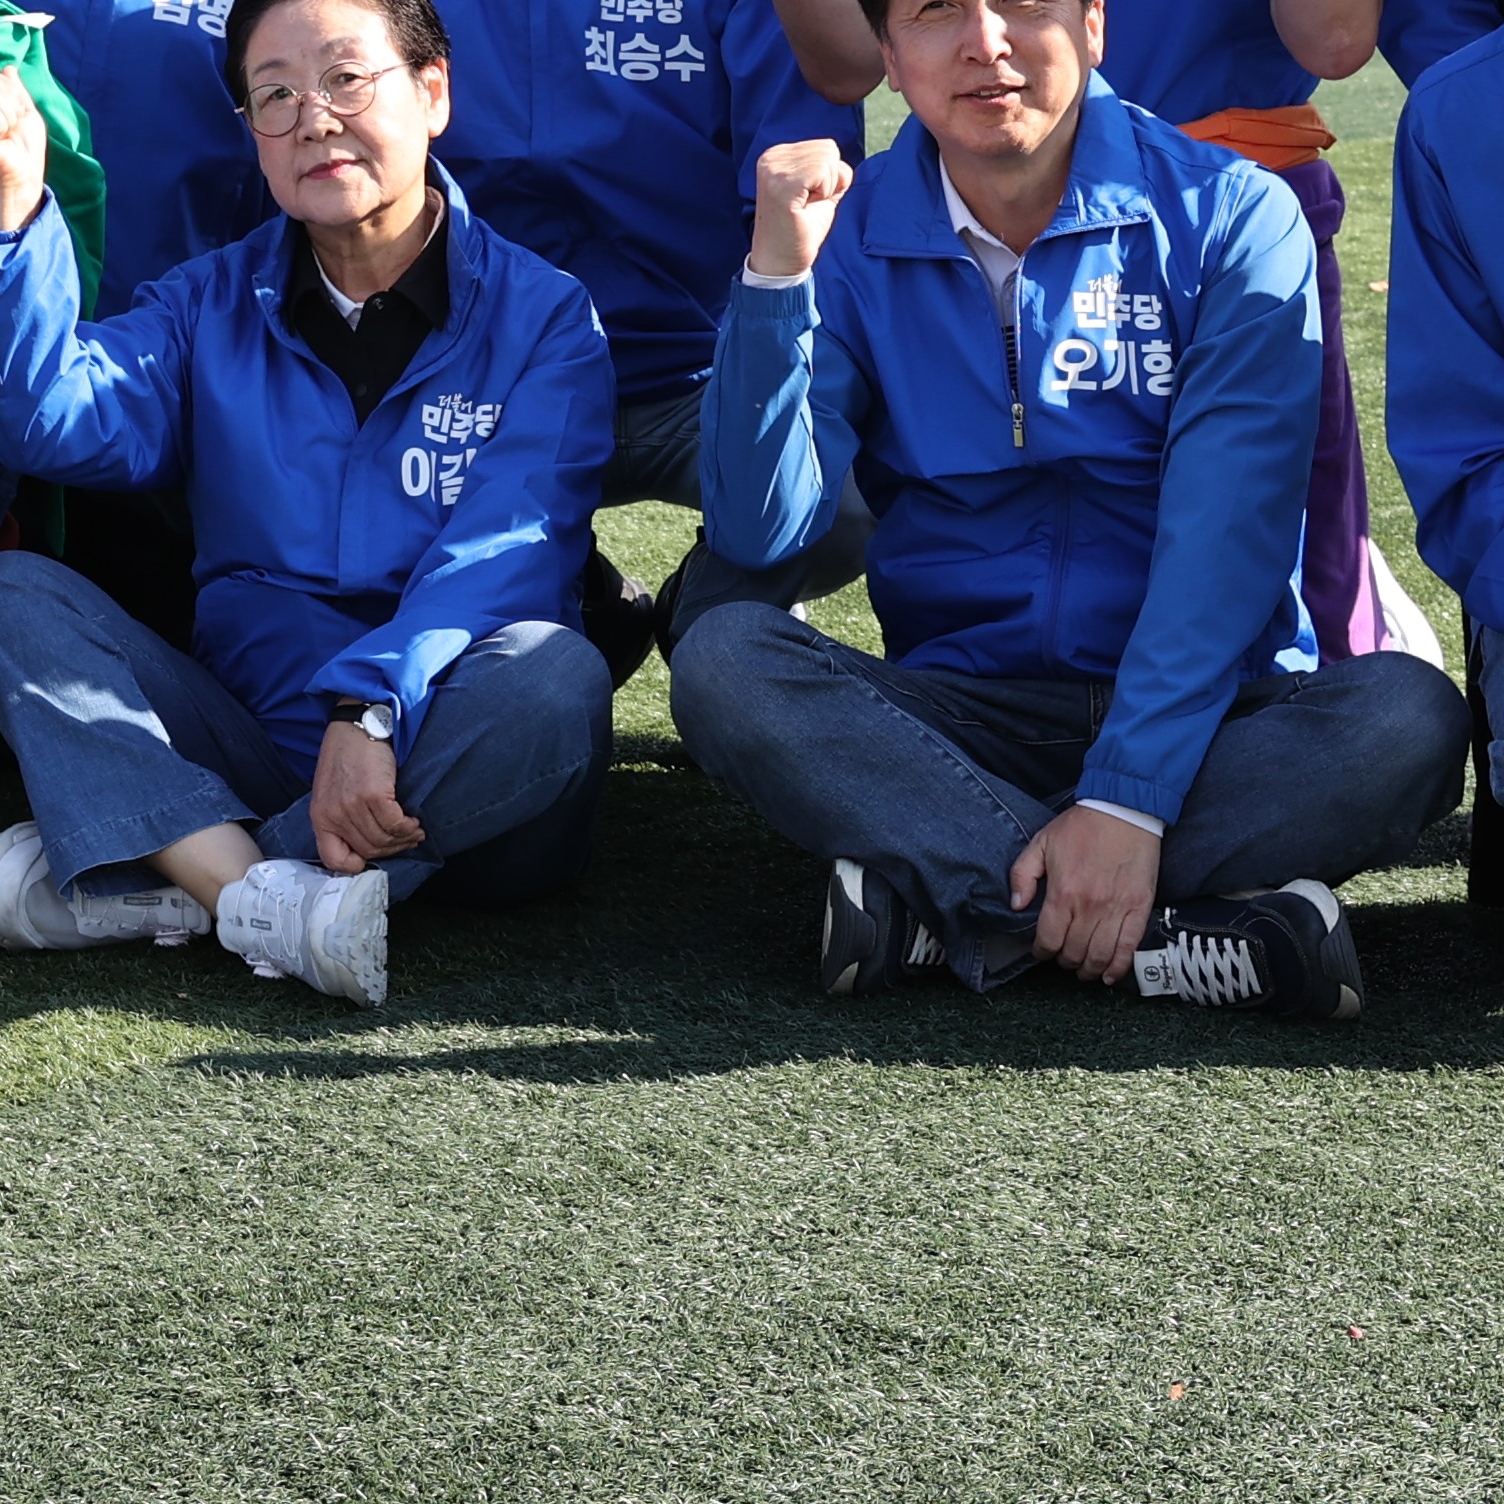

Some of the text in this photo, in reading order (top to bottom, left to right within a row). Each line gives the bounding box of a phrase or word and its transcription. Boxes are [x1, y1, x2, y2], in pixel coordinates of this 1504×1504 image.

[584, 25, 706, 83] 최승수
[1072, 290, 1163, 331] 민주당
[437, 392, 473, 414] 더불어
[421, 403, 503, 445] 민주당
